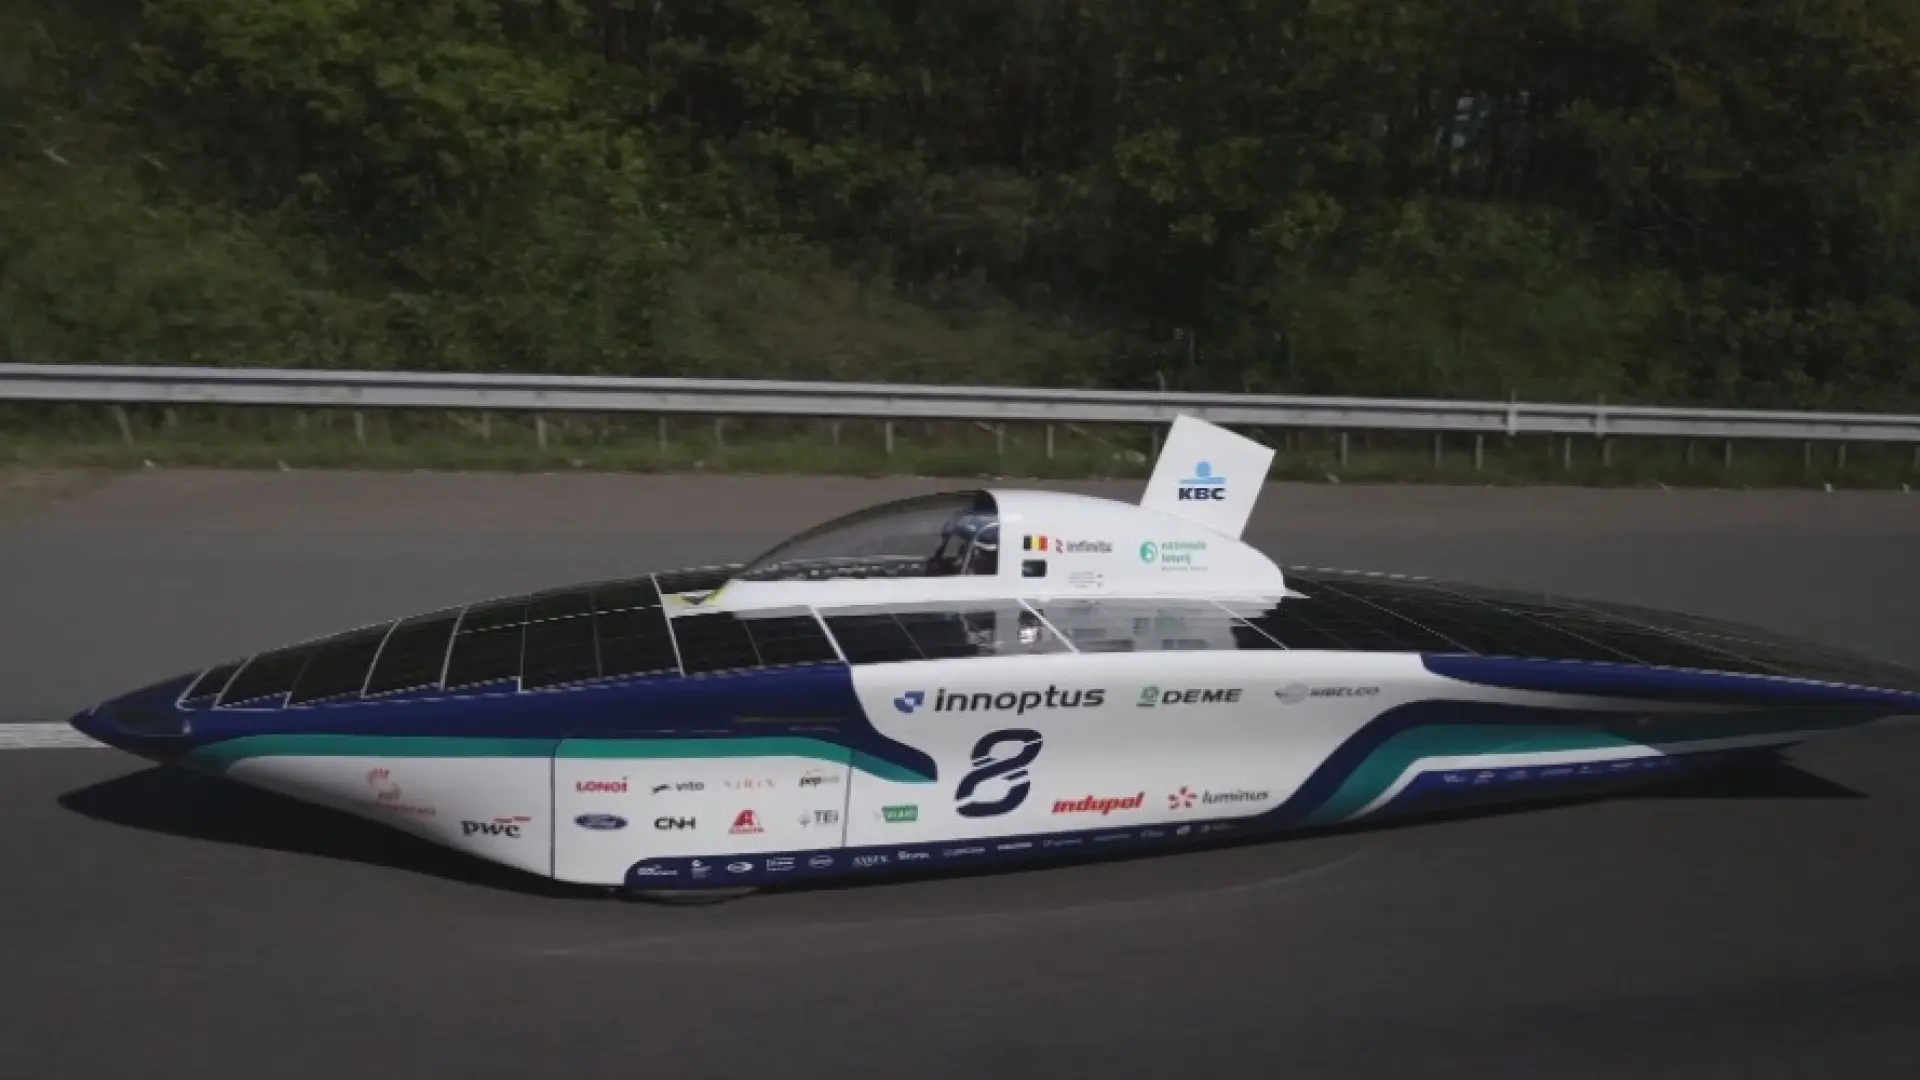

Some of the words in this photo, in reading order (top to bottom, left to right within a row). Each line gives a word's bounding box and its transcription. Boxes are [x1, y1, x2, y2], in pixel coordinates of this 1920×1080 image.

[1178, 487, 1226, 501] KBC
[934, 685, 1107, 715] innoptus
[1162, 688, 1243, 705] DEME
[955, 728, 1043, 817] 8
[1052, 791, 1145, 815] indupol
[461, 820, 521, 838] pwc
[654, 817, 696, 830] CNH
